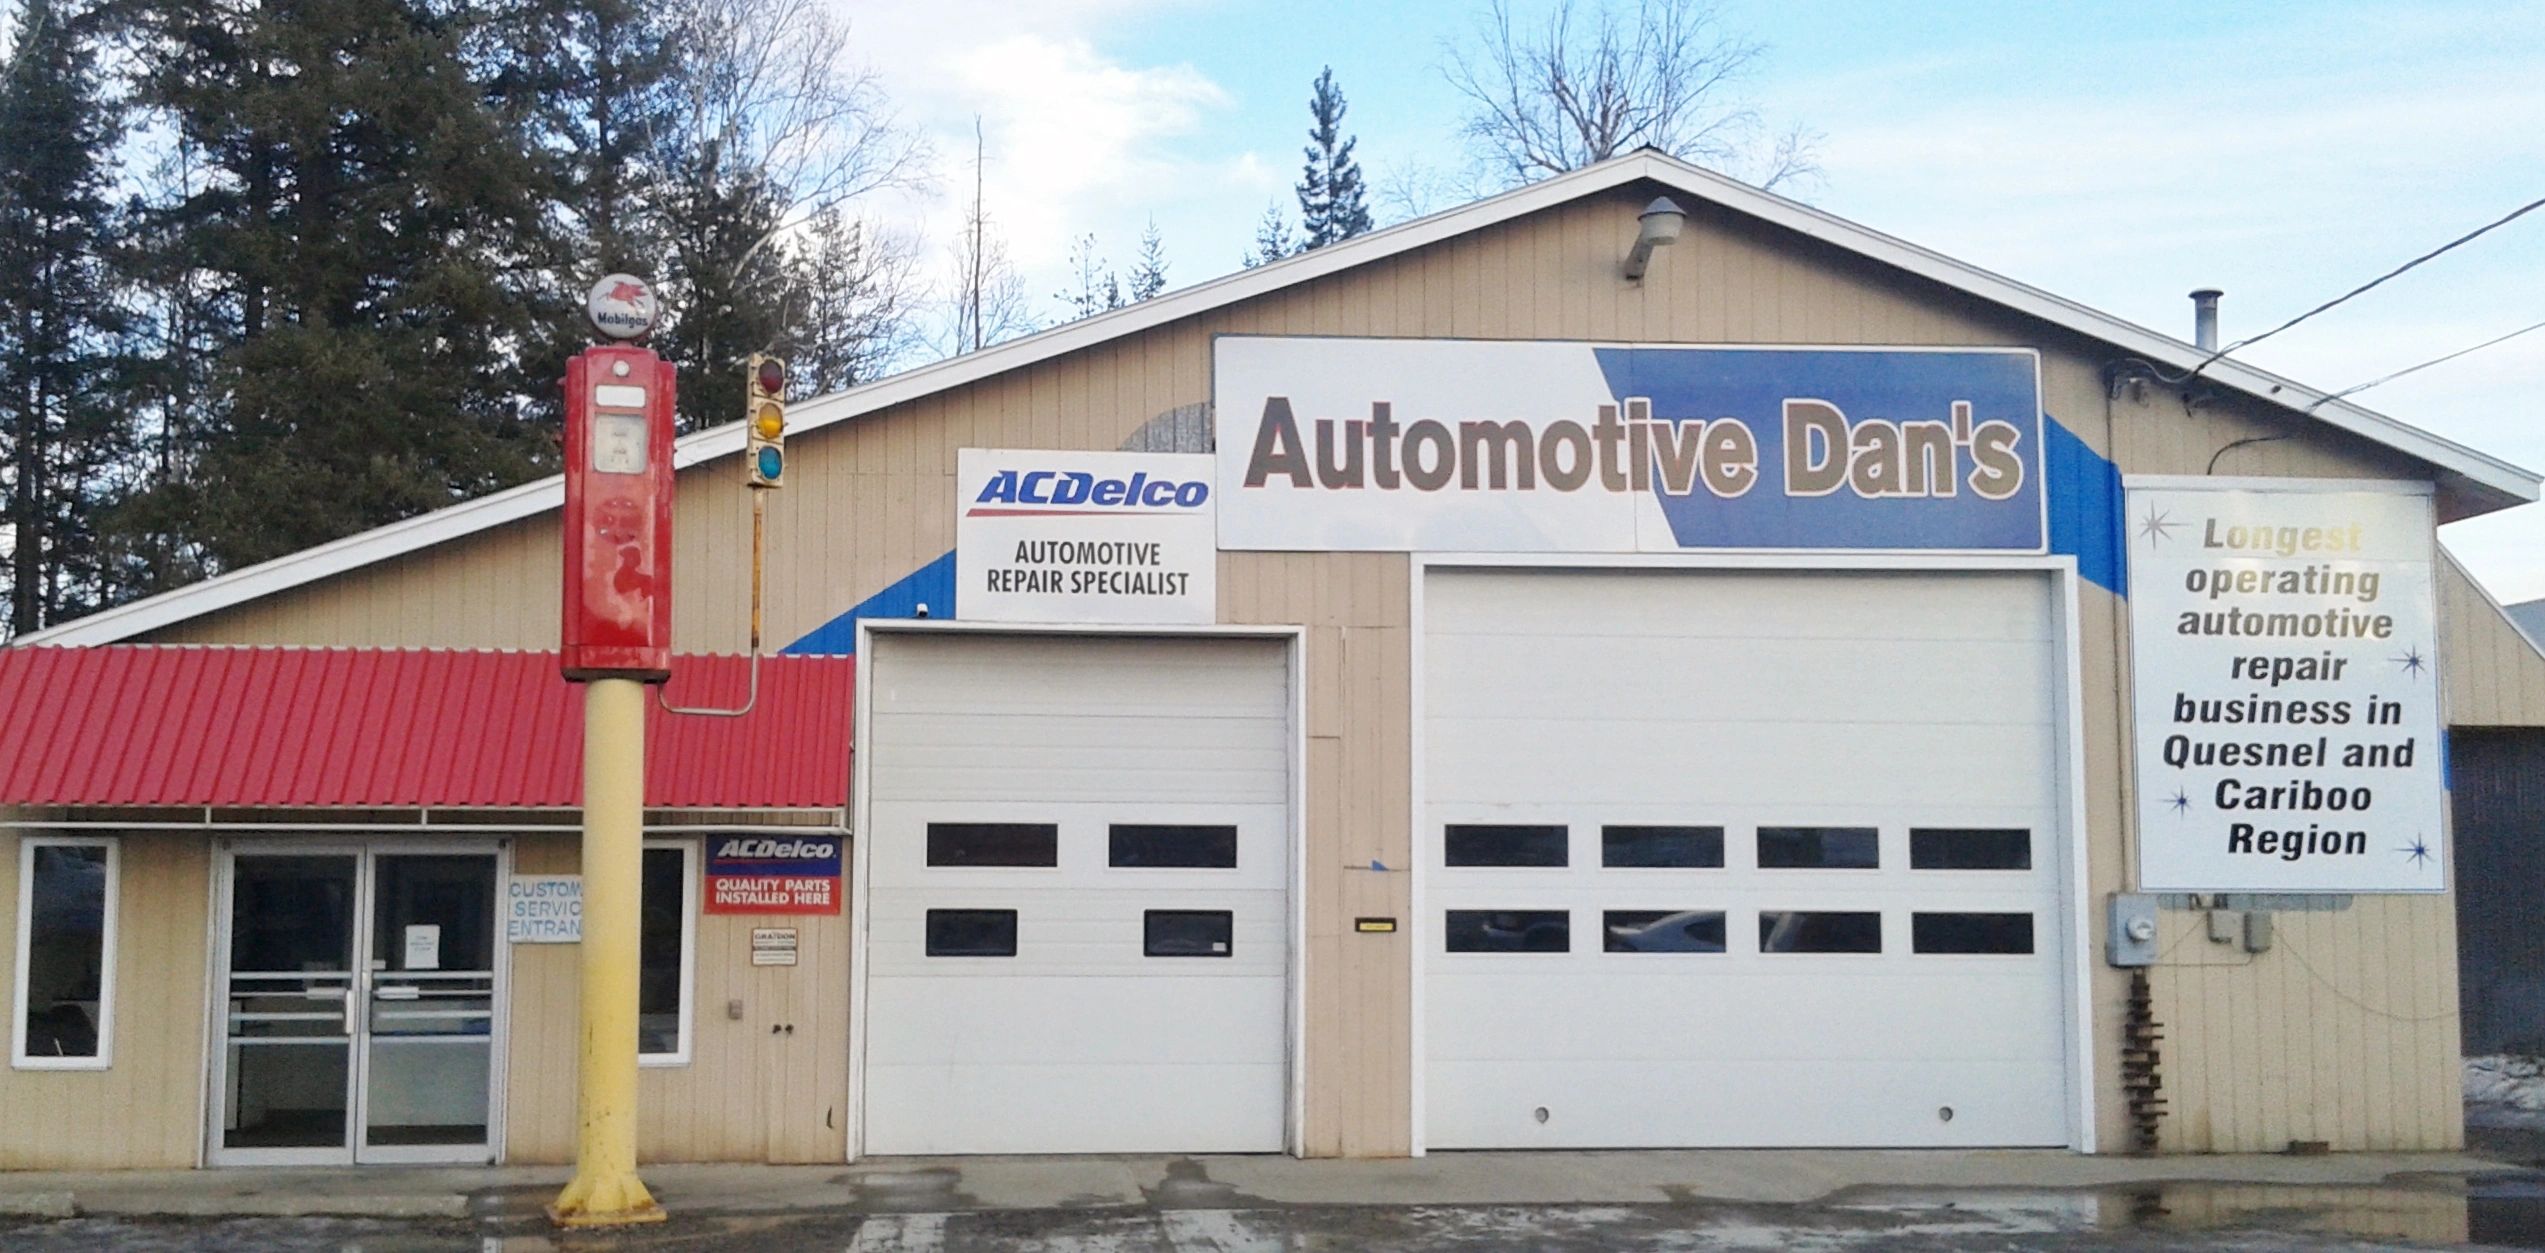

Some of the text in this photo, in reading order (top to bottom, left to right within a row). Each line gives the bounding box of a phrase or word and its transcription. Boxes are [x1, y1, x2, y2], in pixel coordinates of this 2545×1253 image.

[598, 311, 648, 329] Mobilgas
[1243, 396, 2024, 499] Automotive Dan's
[975, 470, 1209, 507] ACDelco
[1014, 540, 1161, 566] AUTOMOTIVE
[2203, 518, 2364, 557] Longest
[987, 569, 1190, 596] REPAIR SPECIALIST
[2185, 564, 2381, 602] operating
[2177, 606, 2394, 639] automotive
[2230, 650, 2348, 687] repair
[2173, 692, 2402, 725] business in
[2163, 734, 2415, 769] Quesnel and
[2214, 778, 2373, 811] Cariboo
[717, 839, 835, 858] ACDelco
[2227, 823, 2367, 861] Region
[716, 878, 831, 892] QUALITY PARTS
[716, 891, 830, 905] INSTALLED HERE
